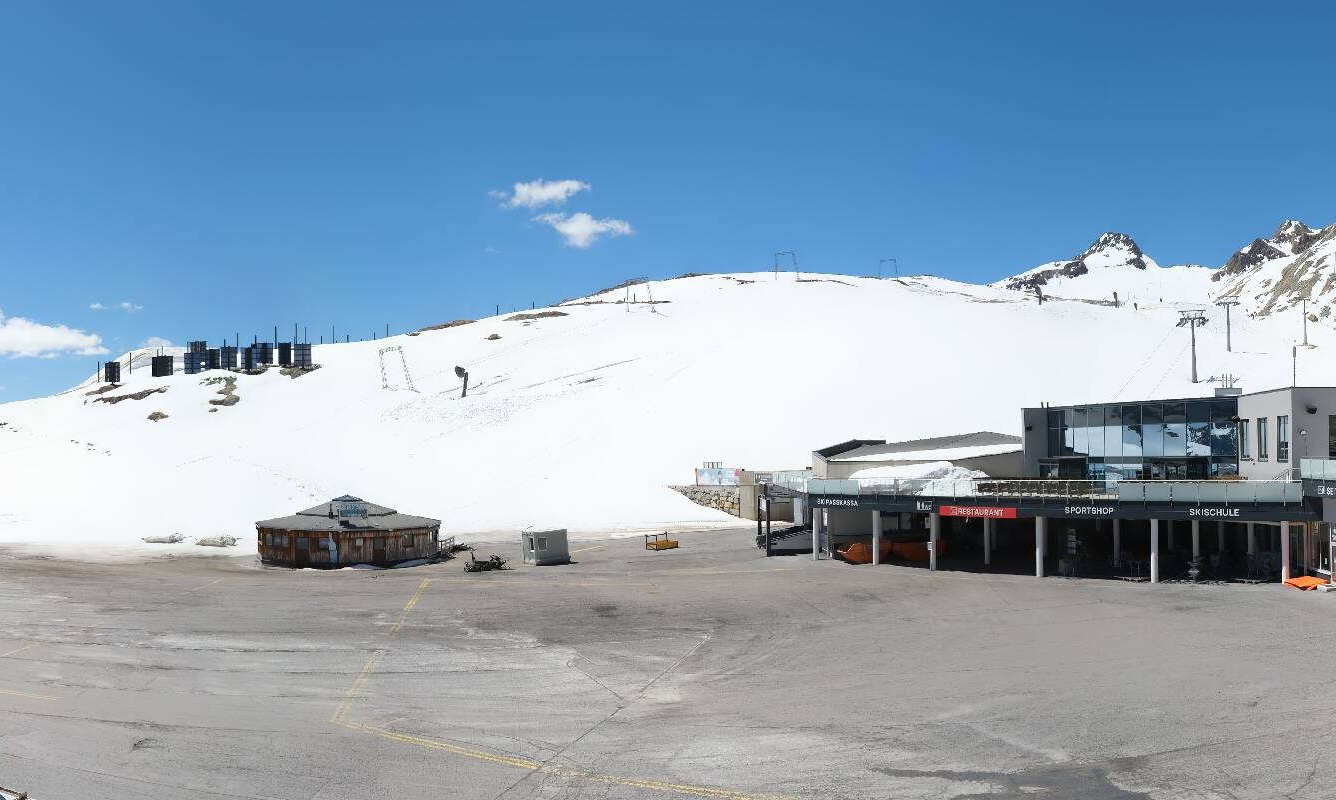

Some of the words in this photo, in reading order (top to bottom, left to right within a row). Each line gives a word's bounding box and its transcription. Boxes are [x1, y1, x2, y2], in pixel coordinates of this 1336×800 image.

[817, 498, 859, 507] SKPASSKASSA
[957, 506, 1004, 517] RESTAURANT
[1064, 506, 1114, 515] SPORTSHOP
[1189, 508, 1240, 517] SKISCHULE
